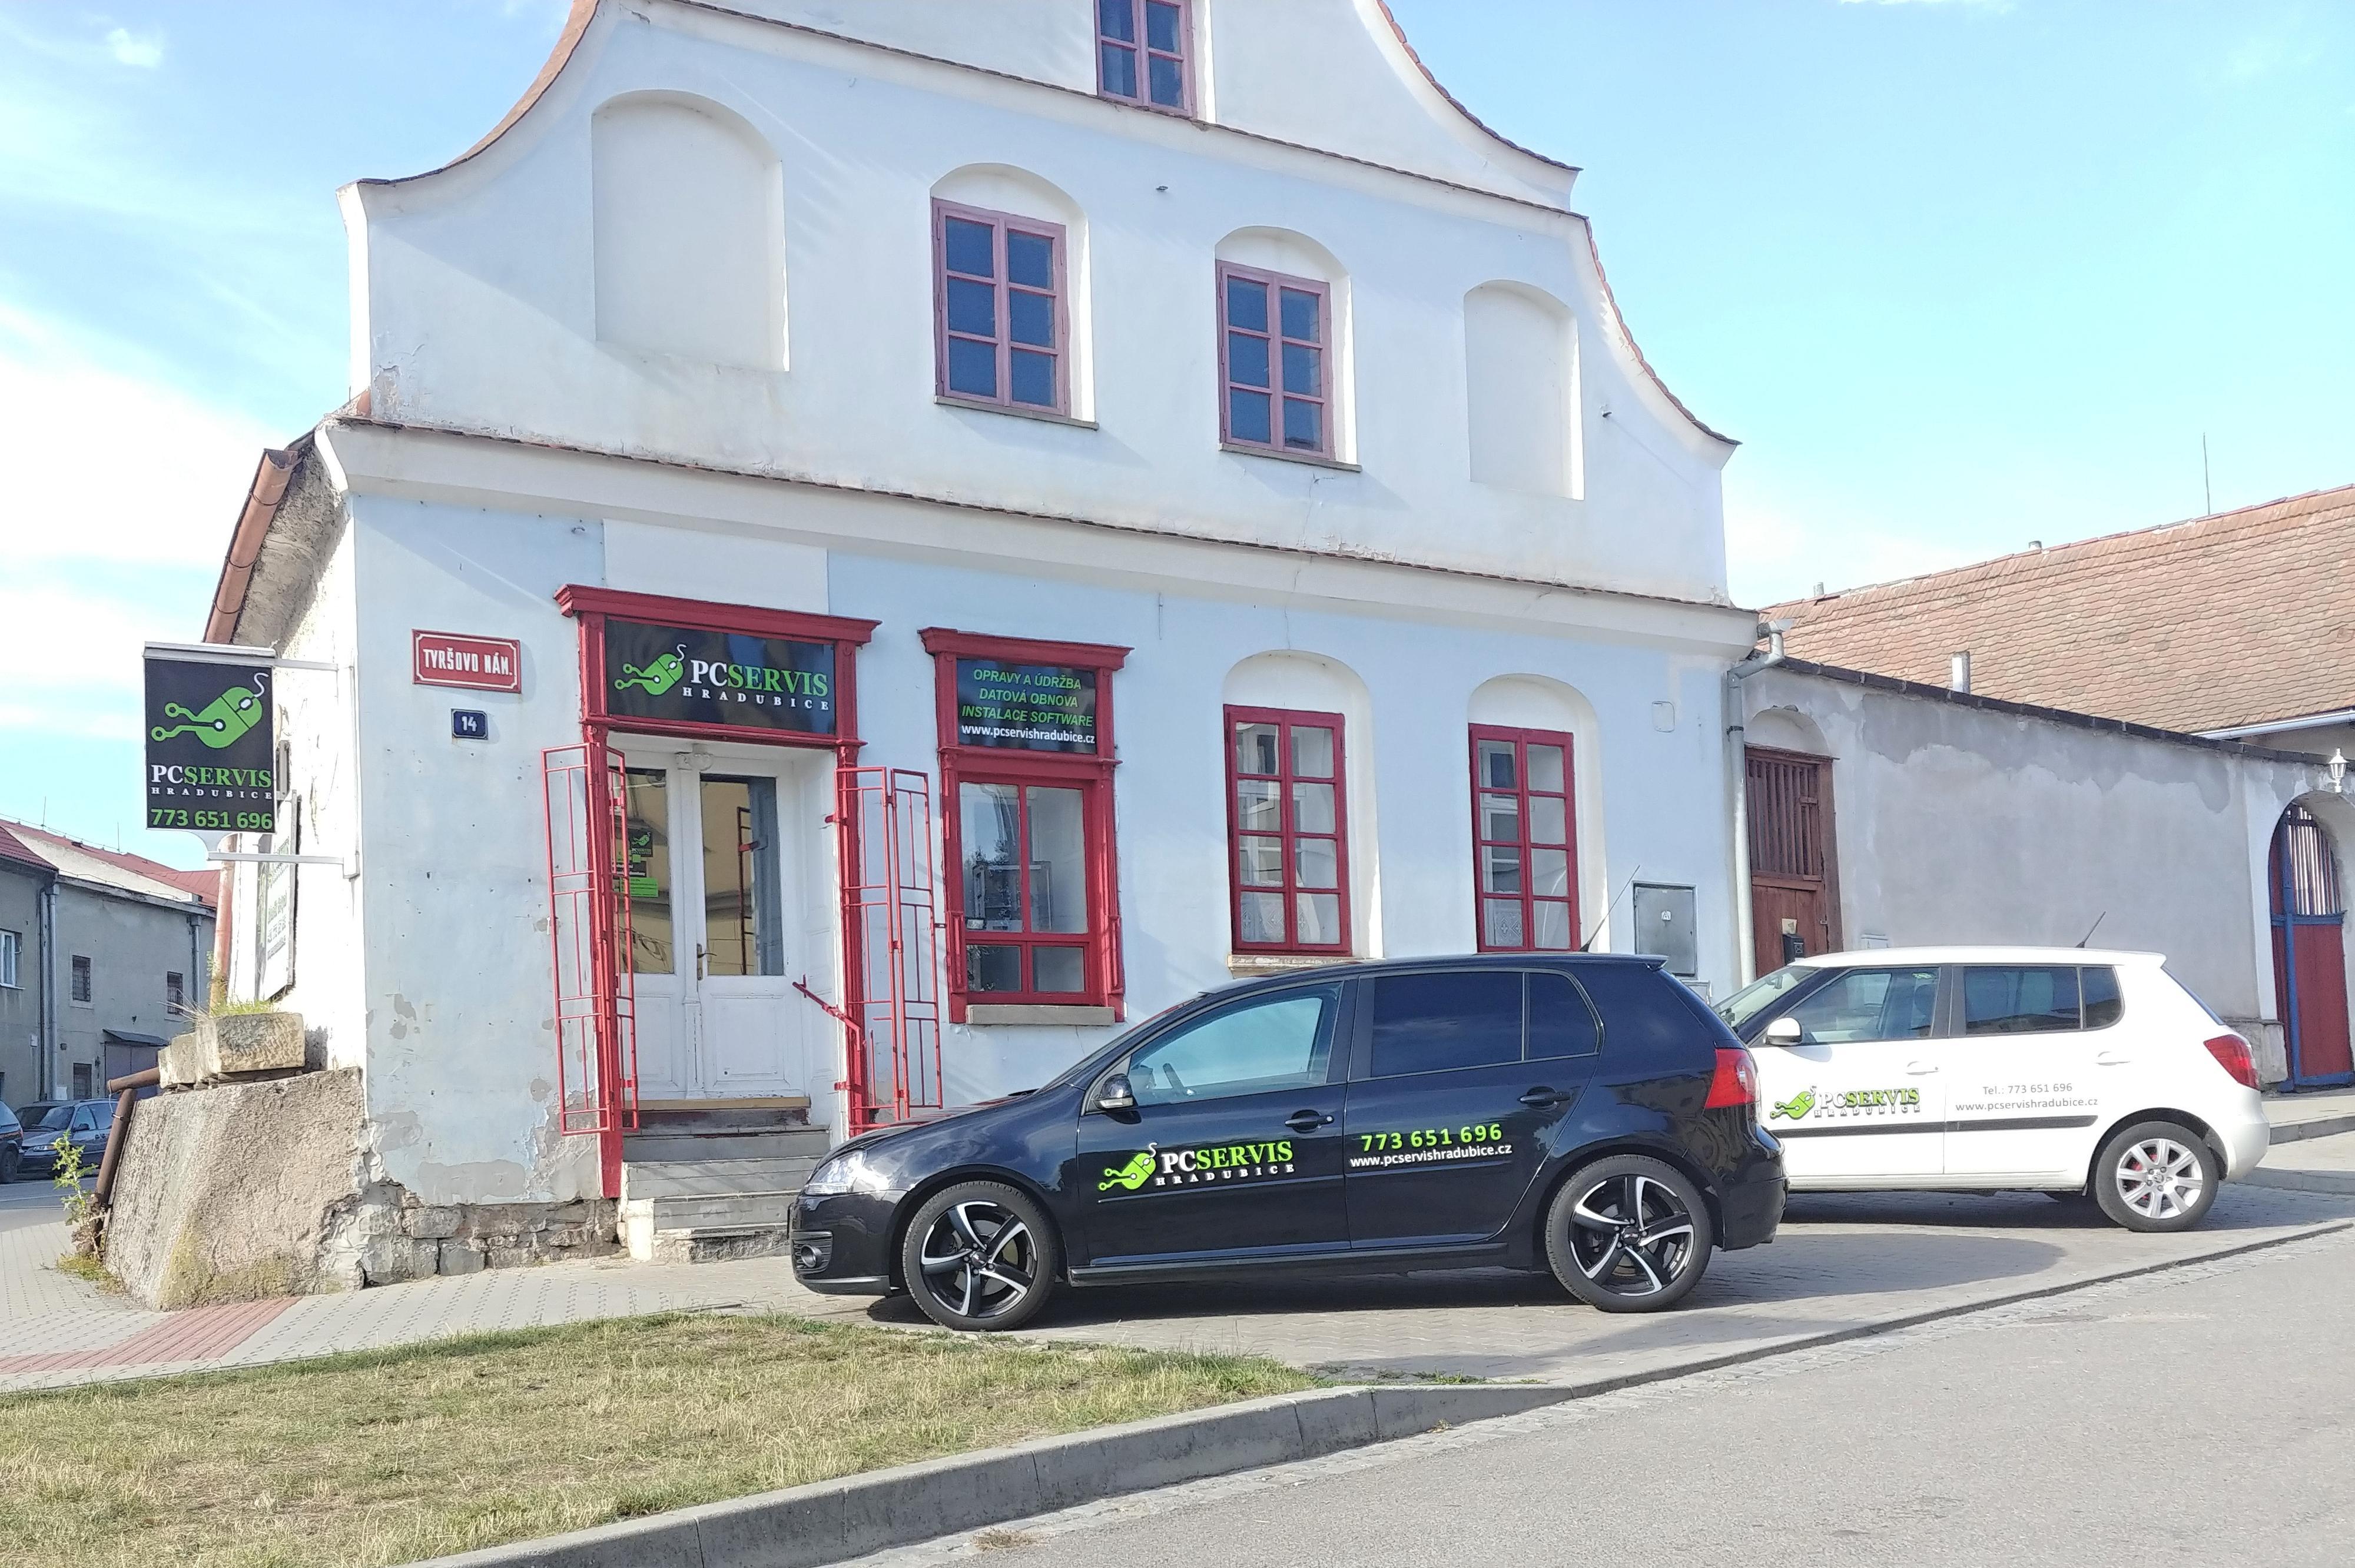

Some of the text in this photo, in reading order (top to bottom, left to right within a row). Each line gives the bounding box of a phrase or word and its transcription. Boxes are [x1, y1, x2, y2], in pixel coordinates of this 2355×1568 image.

[423, 647, 513, 676] TYRŠOVO NÁM.
[974, 669, 1082, 690] OPRAVY A ÚDRŽBA
[682, 687, 829, 710] HRADUBICE
[979, 687, 1078, 707] DATOVÁ OBNOVA
[461, 716, 477, 732] 14
[962, 706, 1093, 727] INSTALACE SOFTWARE
[961, 724, 1095, 744] www.pcservishradubice.cz
[151, 787, 273, 799] HRADUBICE
[151, 809, 273, 830] 773 651 696
[1982, 1083, 2072, 1095] Tel.: 773 651 696
[1814, 1104, 1921, 1118] HRADUBICE
[1955, 1097, 2098, 1111] www.pcservishradubice.cz
[1361, 1124, 1502, 1151] 773 651 696
[1350, 1144, 1512, 1167] www.pcservishradubice.cz
[1155, 1163, 1294, 1187] HRADUBICE
